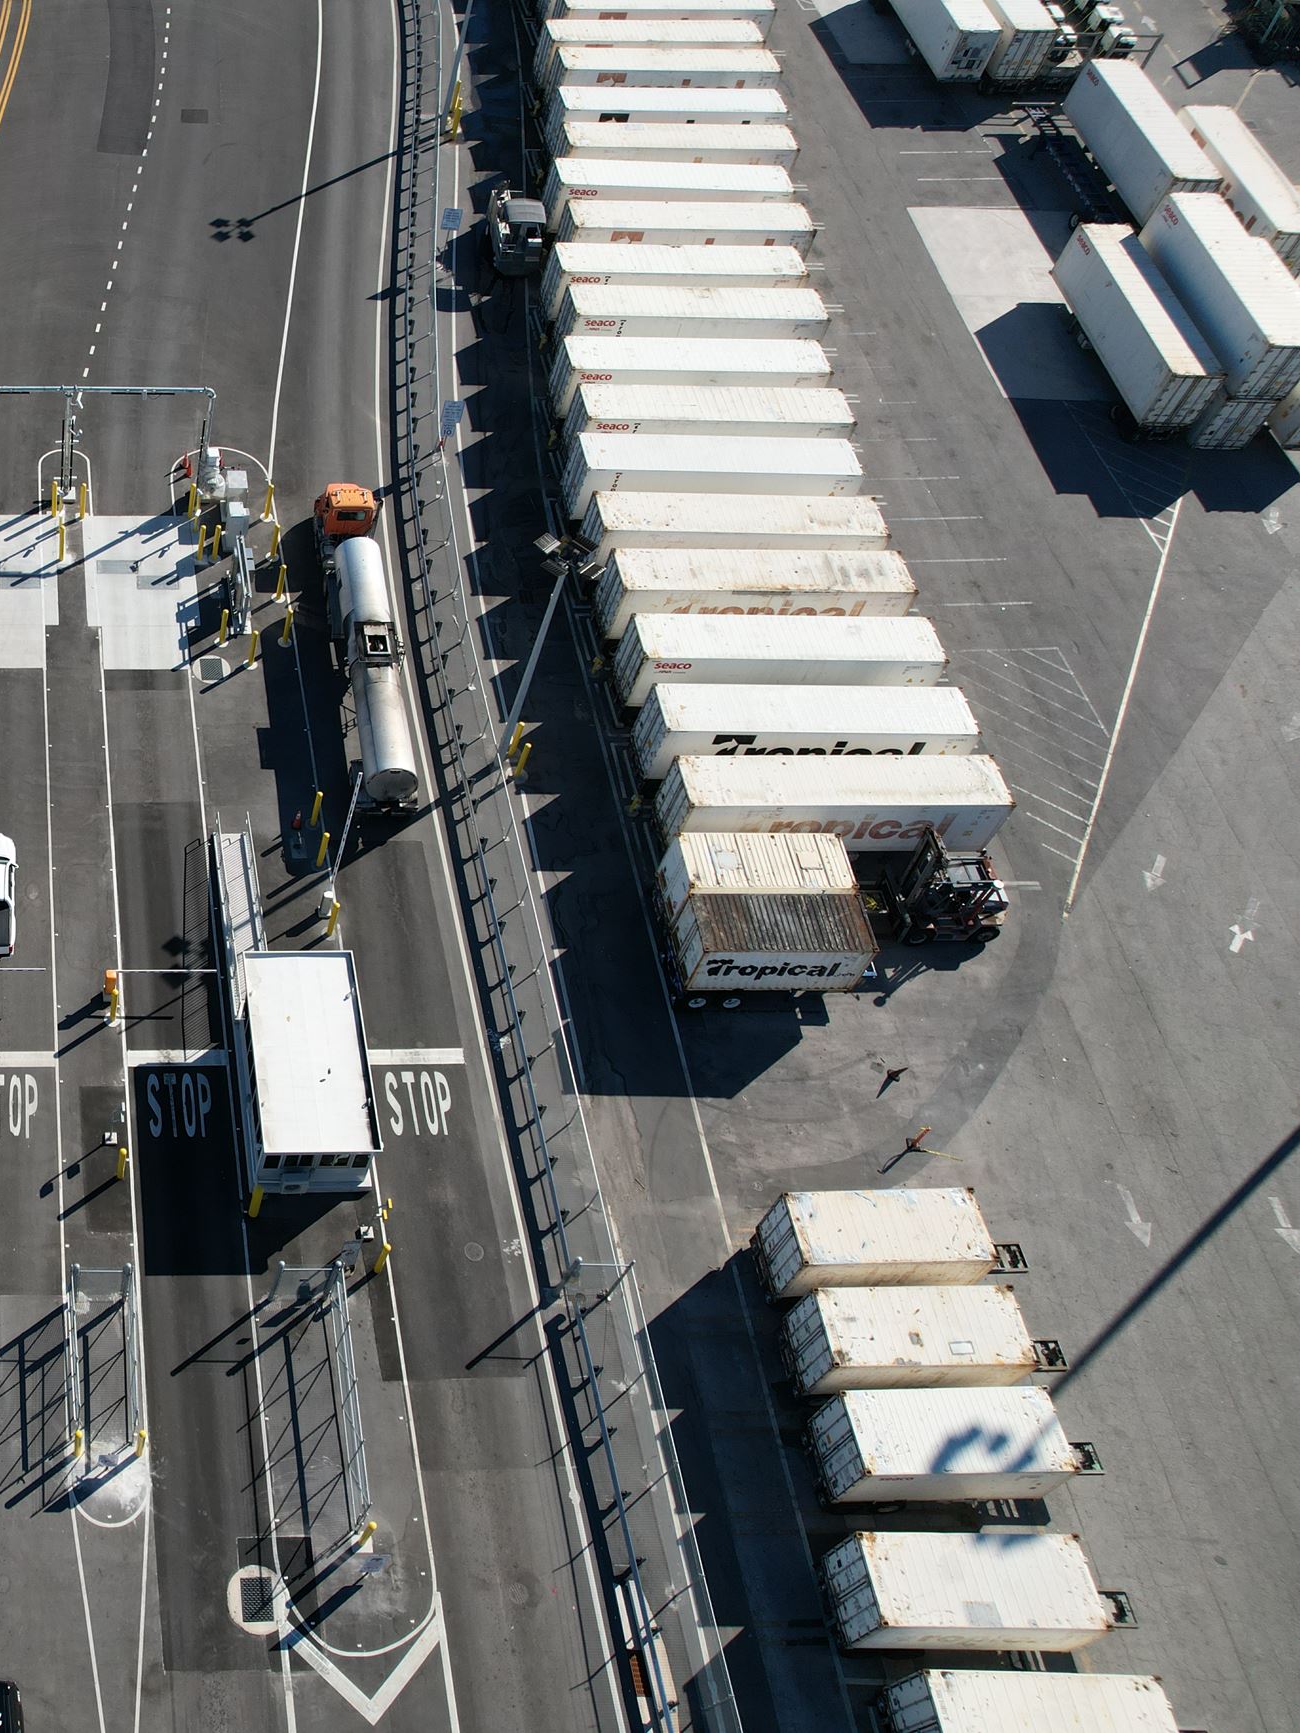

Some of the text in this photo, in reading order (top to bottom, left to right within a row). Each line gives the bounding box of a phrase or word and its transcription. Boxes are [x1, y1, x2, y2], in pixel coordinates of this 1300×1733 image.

[568, 188, 598, 196] seaco
[570, 276, 601, 284] seaco
[584, 319, 616, 327] seaco
[580, 373, 612, 381] seaco
[596, 423, 630, 431] seaco
[706, 958, 842, 981] Tropical
[146, 1073, 212, 1139] STOP
[384, 1071, 451, 1137] STOP
